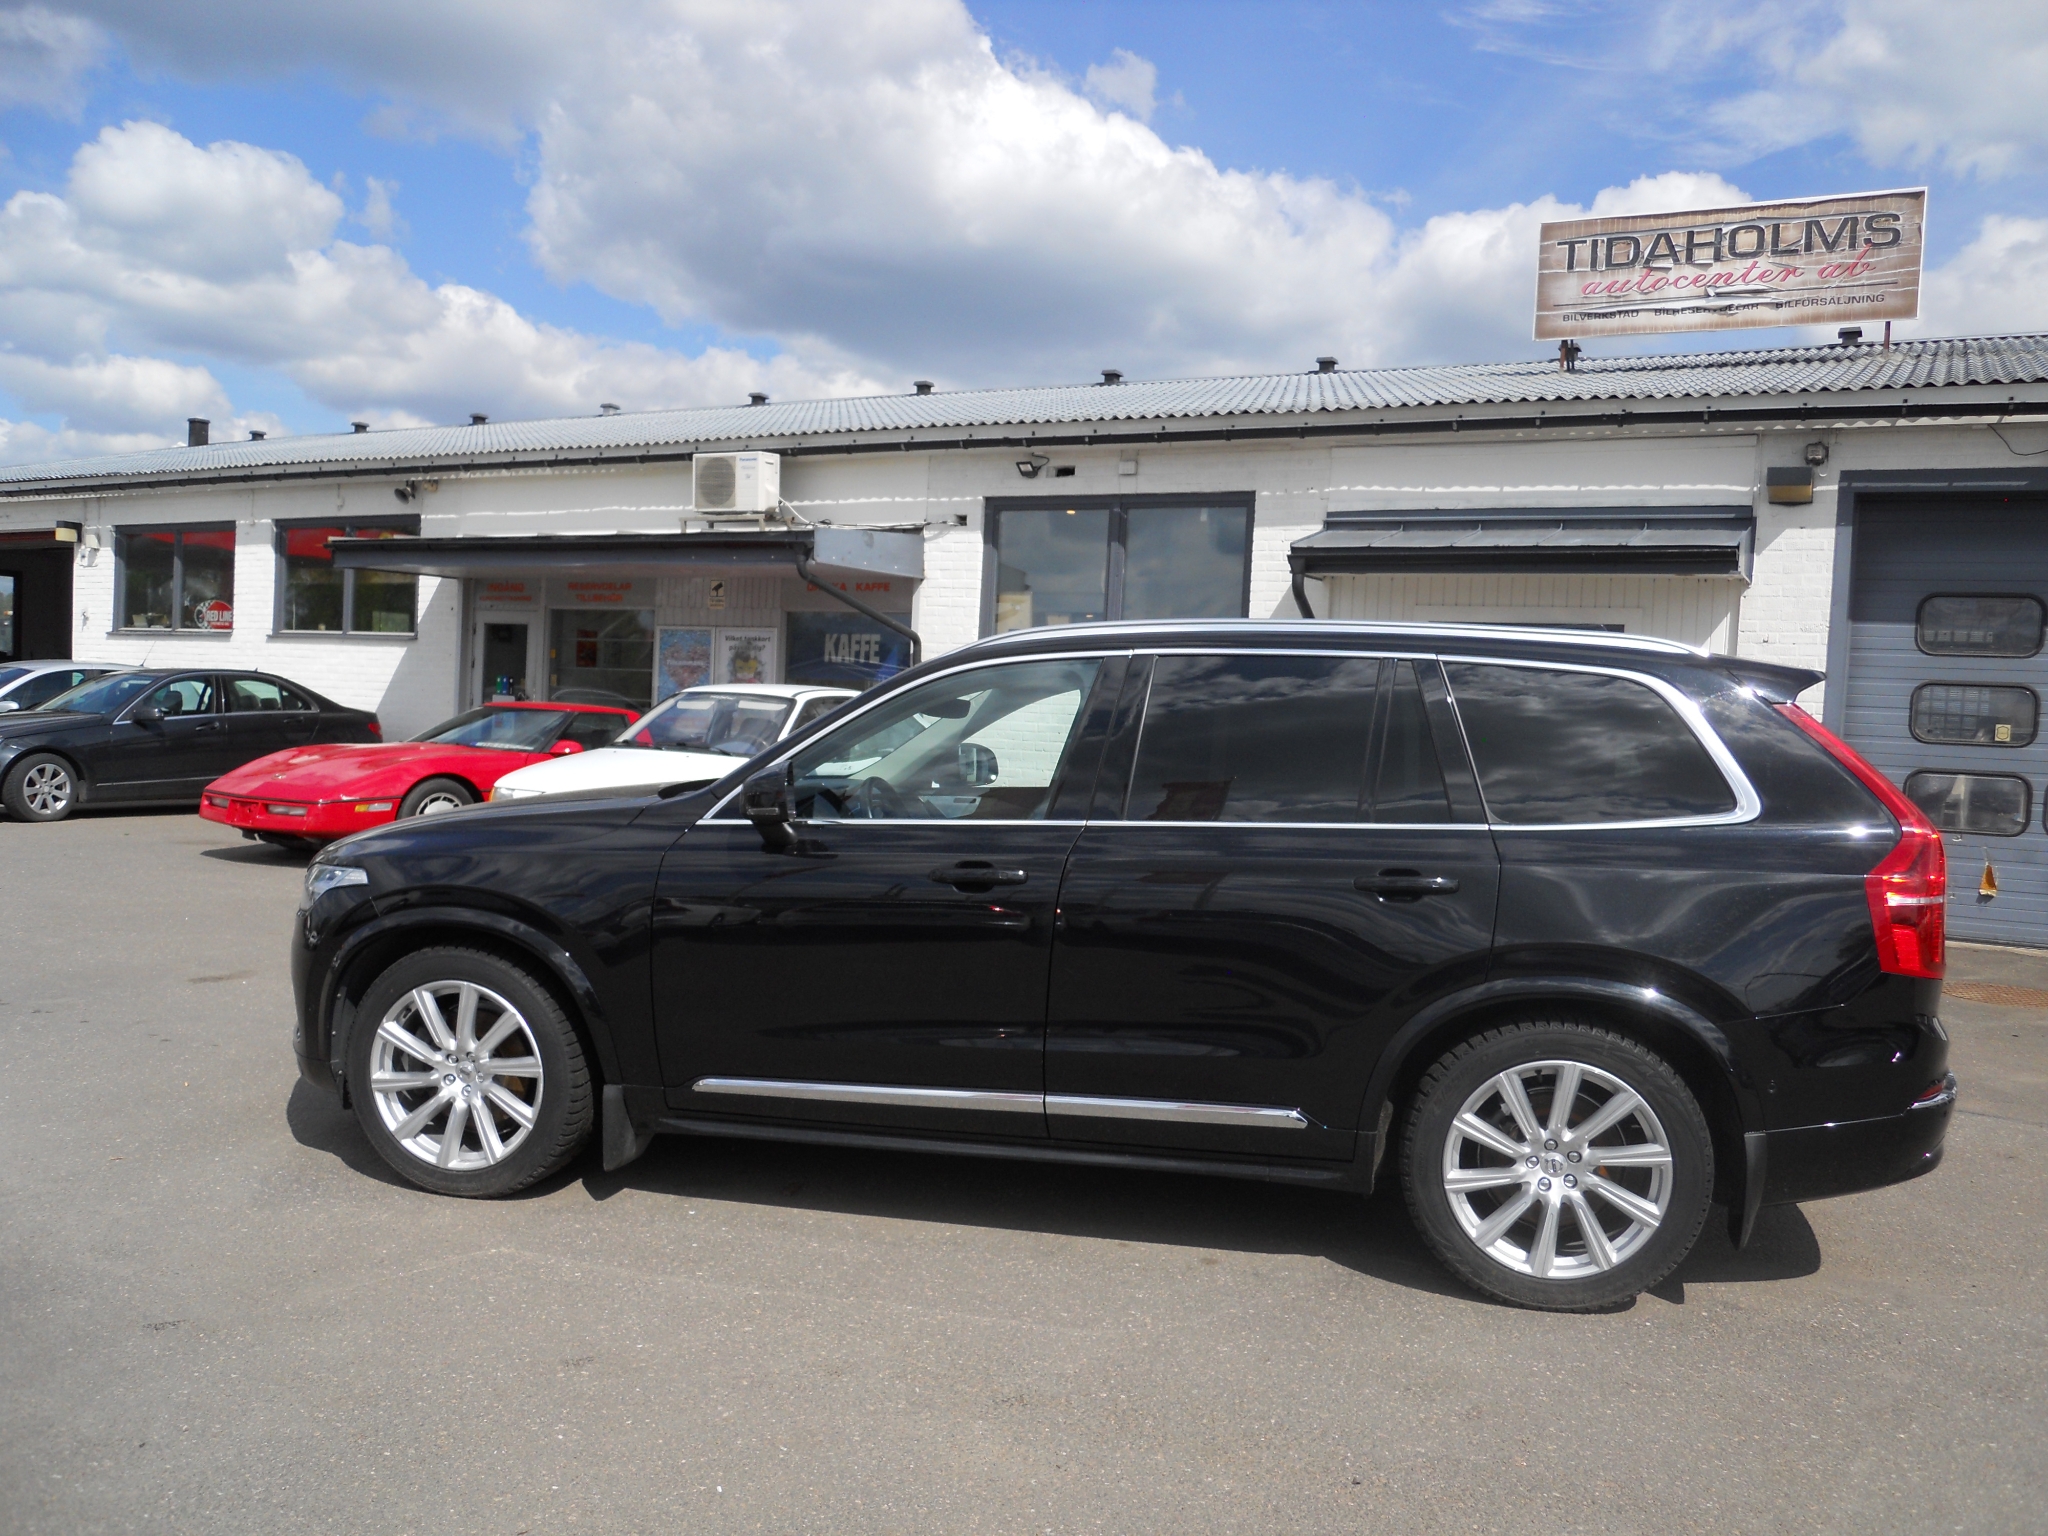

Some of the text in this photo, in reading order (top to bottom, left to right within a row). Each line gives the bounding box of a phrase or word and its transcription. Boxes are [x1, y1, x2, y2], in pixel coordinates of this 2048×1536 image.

[1556, 213, 1902, 272] TIDAHOLMS
[1581, 245, 1878, 296] autocenter ab
[1562, 309, 1640, 323] BILVERKSTAD
[855, 582, 891, 592] KAFFE
[206, 610, 218, 621] RED
[824, 633, 881, 663] KAFFE
